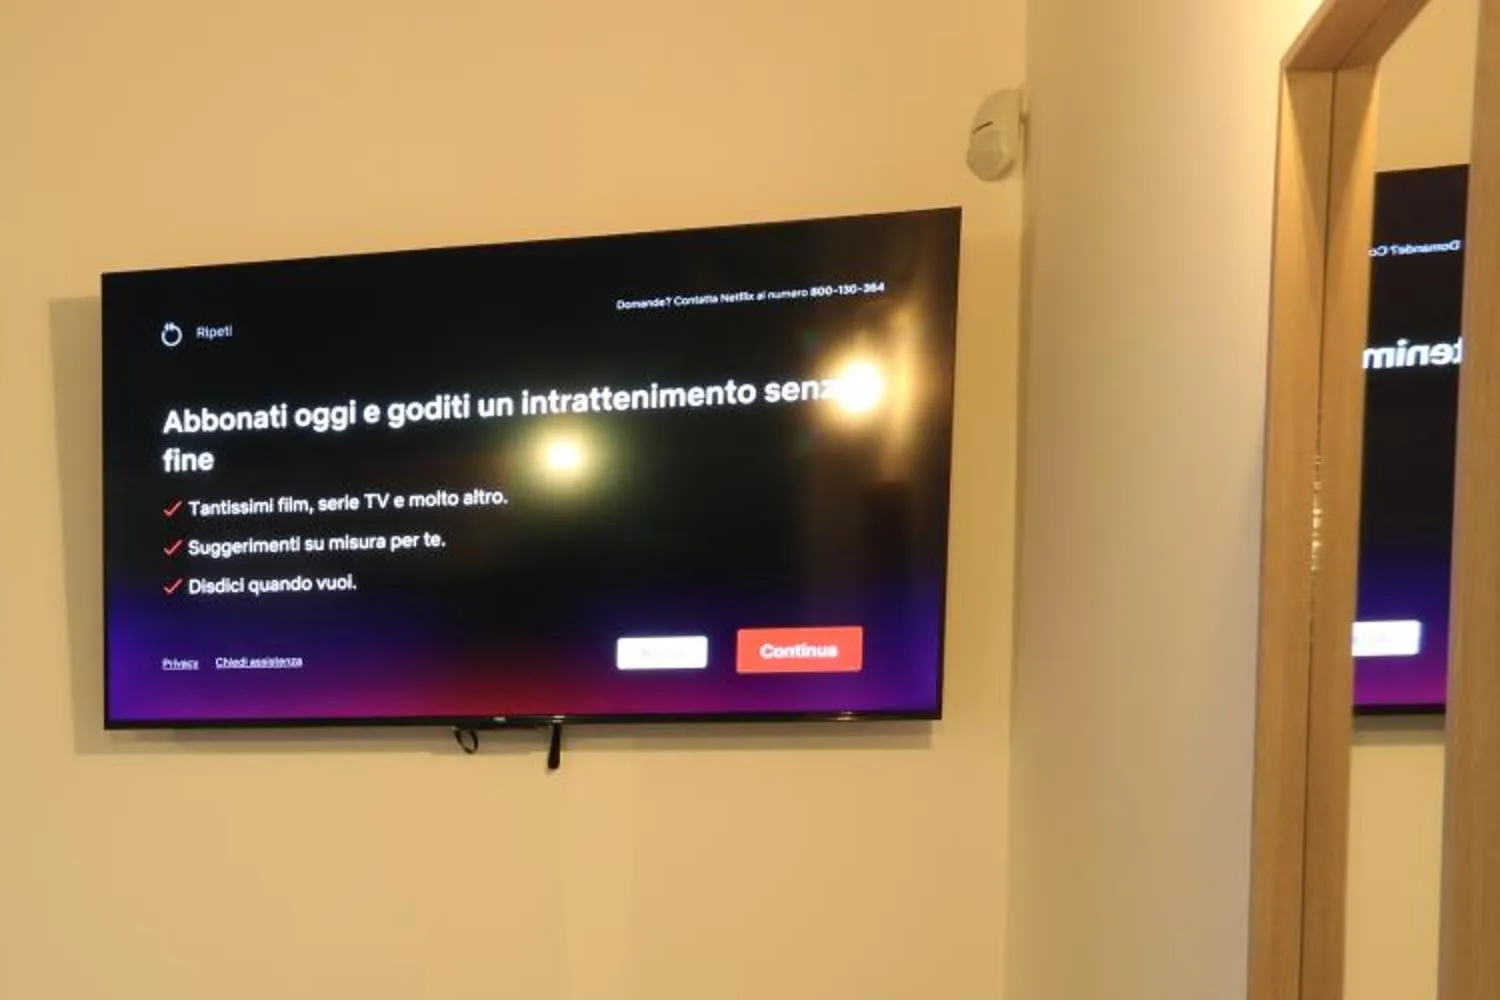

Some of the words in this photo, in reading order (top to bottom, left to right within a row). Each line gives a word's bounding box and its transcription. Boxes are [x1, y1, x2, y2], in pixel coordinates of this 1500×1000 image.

[616, 297, 672, 311] Domande?
[673, 293, 719, 307] Contatta
[720, 291, 755, 303] Netflix
[767, 288, 809, 300] numero
[196, 323, 233, 341] Ripeti
[162, 403, 288, 434] Abbonati
[294, 400, 358, 432] oggi
[363, 403, 381, 424] e
[387, 393, 472, 428] goditi
[477, 394, 514, 418] un
[520, 378, 757, 415] intrattenimento
[763, 377, 860, 403] senz
[162, 448, 215, 473] fine
[188, 495, 274, 517] Tantissimi
[277, 495, 315, 515] film,
[317, 494, 360, 512] serie
[364, 493, 390, 510] TV
[394, 495, 405, 509] e
[408, 489, 458, 508] molto
[462, 488, 509, 506] altro.
[188, 536, 301, 560] Suggerimenti
[304, 537, 325, 552] su
[328, 534, 387, 552] misura
[390, 534, 419, 553] per
[423, 531, 447, 549] te.
[188, 578, 245, 596] Disdici
[248, 576, 313, 596] quando
[315, 573, 358, 592] vuoi.
[759, 643, 839, 660] Continua
